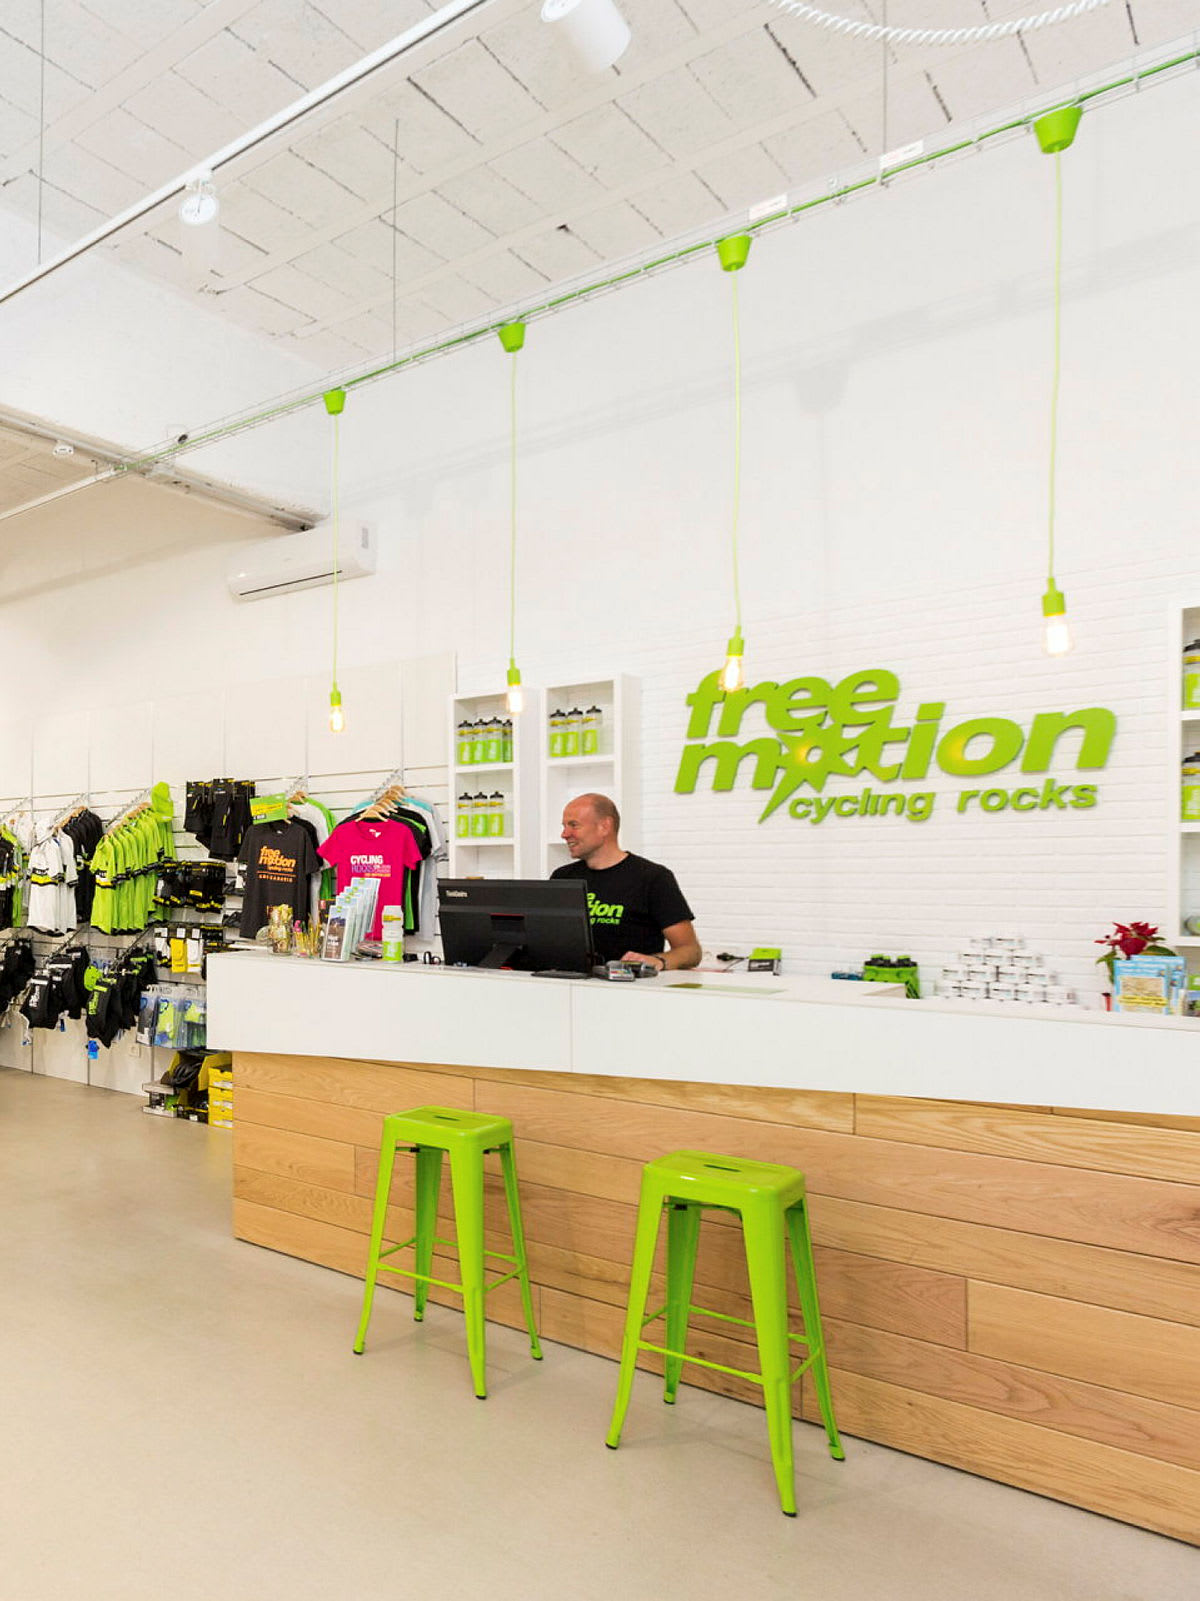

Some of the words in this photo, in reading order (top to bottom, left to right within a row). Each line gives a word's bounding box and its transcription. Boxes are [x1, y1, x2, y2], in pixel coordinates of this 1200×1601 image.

[686, 669, 900, 739] free
[673, 701, 1118, 820] motion
[788, 784, 936, 824] cycling
[956, 778, 1098, 814] rocks
[260, 845, 281, 857] free
[350, 854, 383, 865] CYCLING
